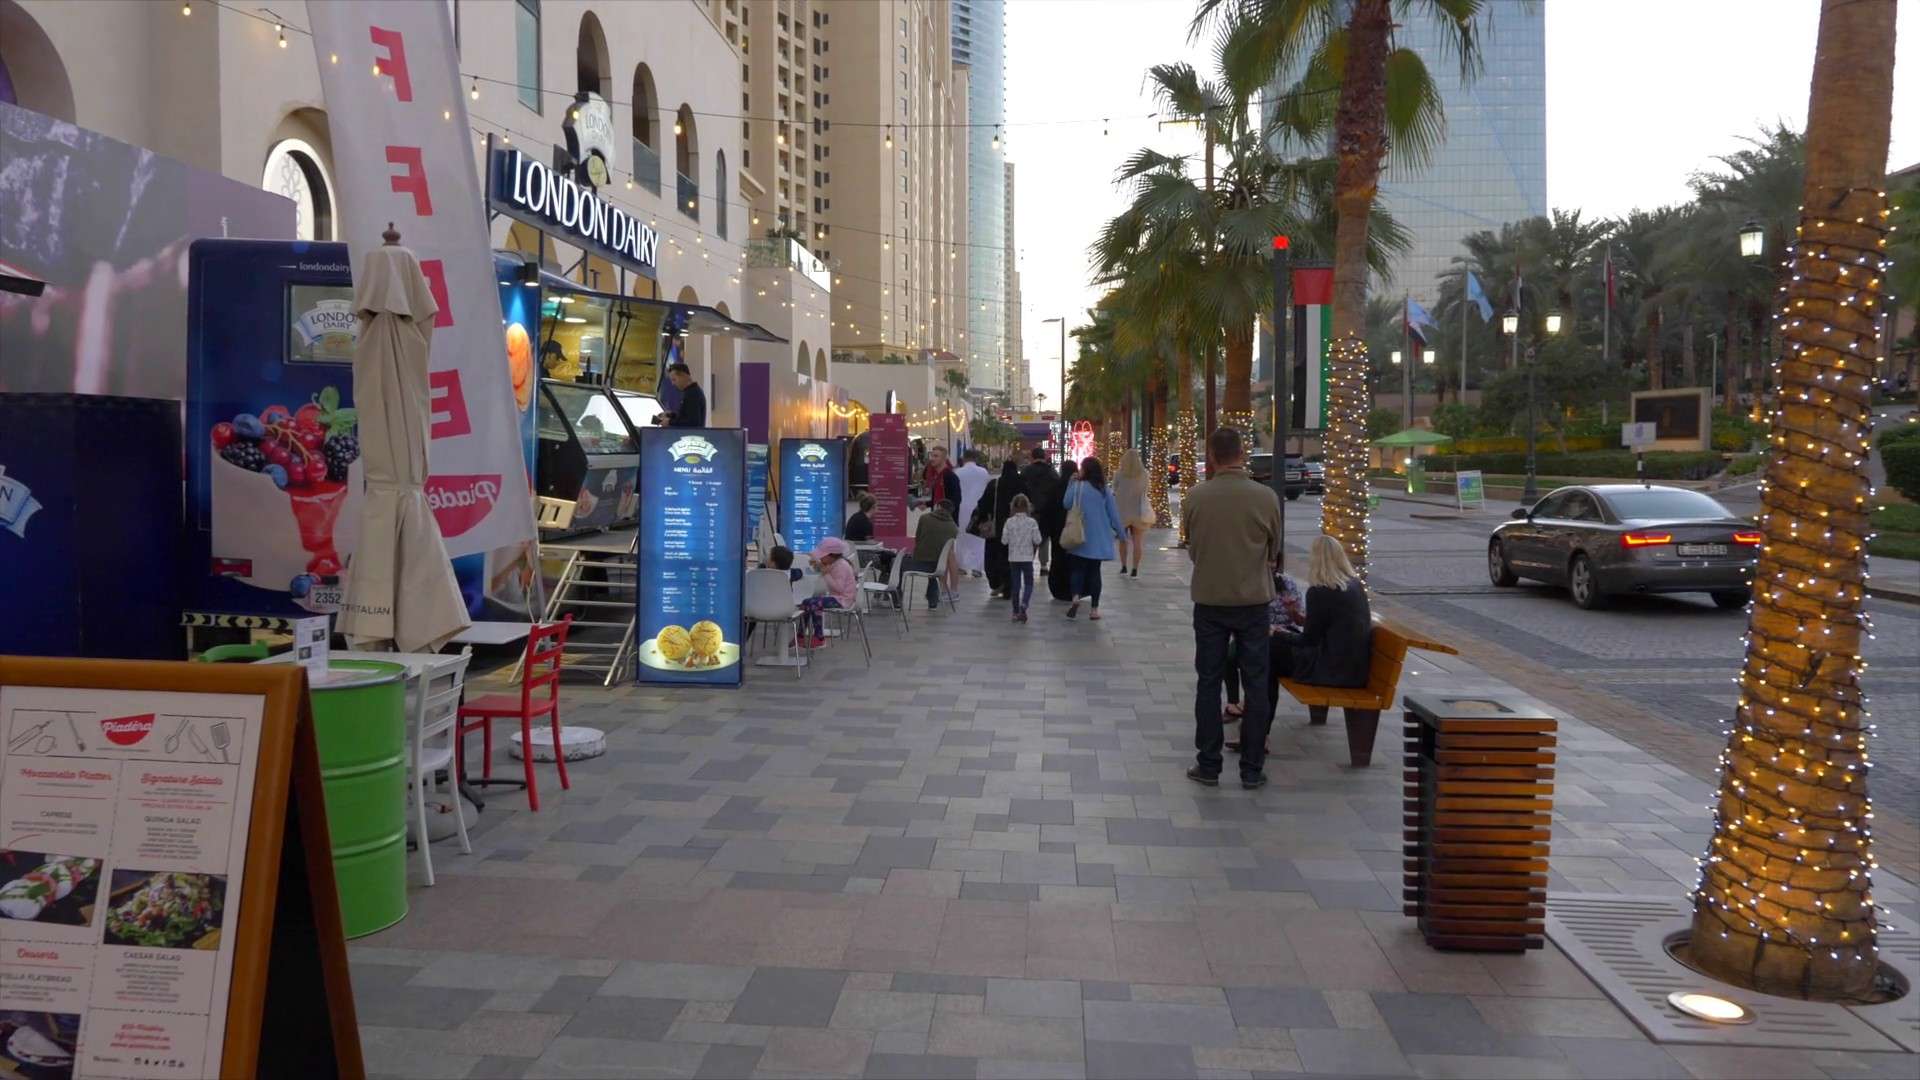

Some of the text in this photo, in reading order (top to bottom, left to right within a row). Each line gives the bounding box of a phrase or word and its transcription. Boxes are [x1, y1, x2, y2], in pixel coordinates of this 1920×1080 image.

[513, 150, 659, 268] LONDON DAIRY
[311, 311, 358, 325] LONDO
[323, 321, 353, 330] DAIRY
[123, 951, 182, 961] CAESAR SALAD
